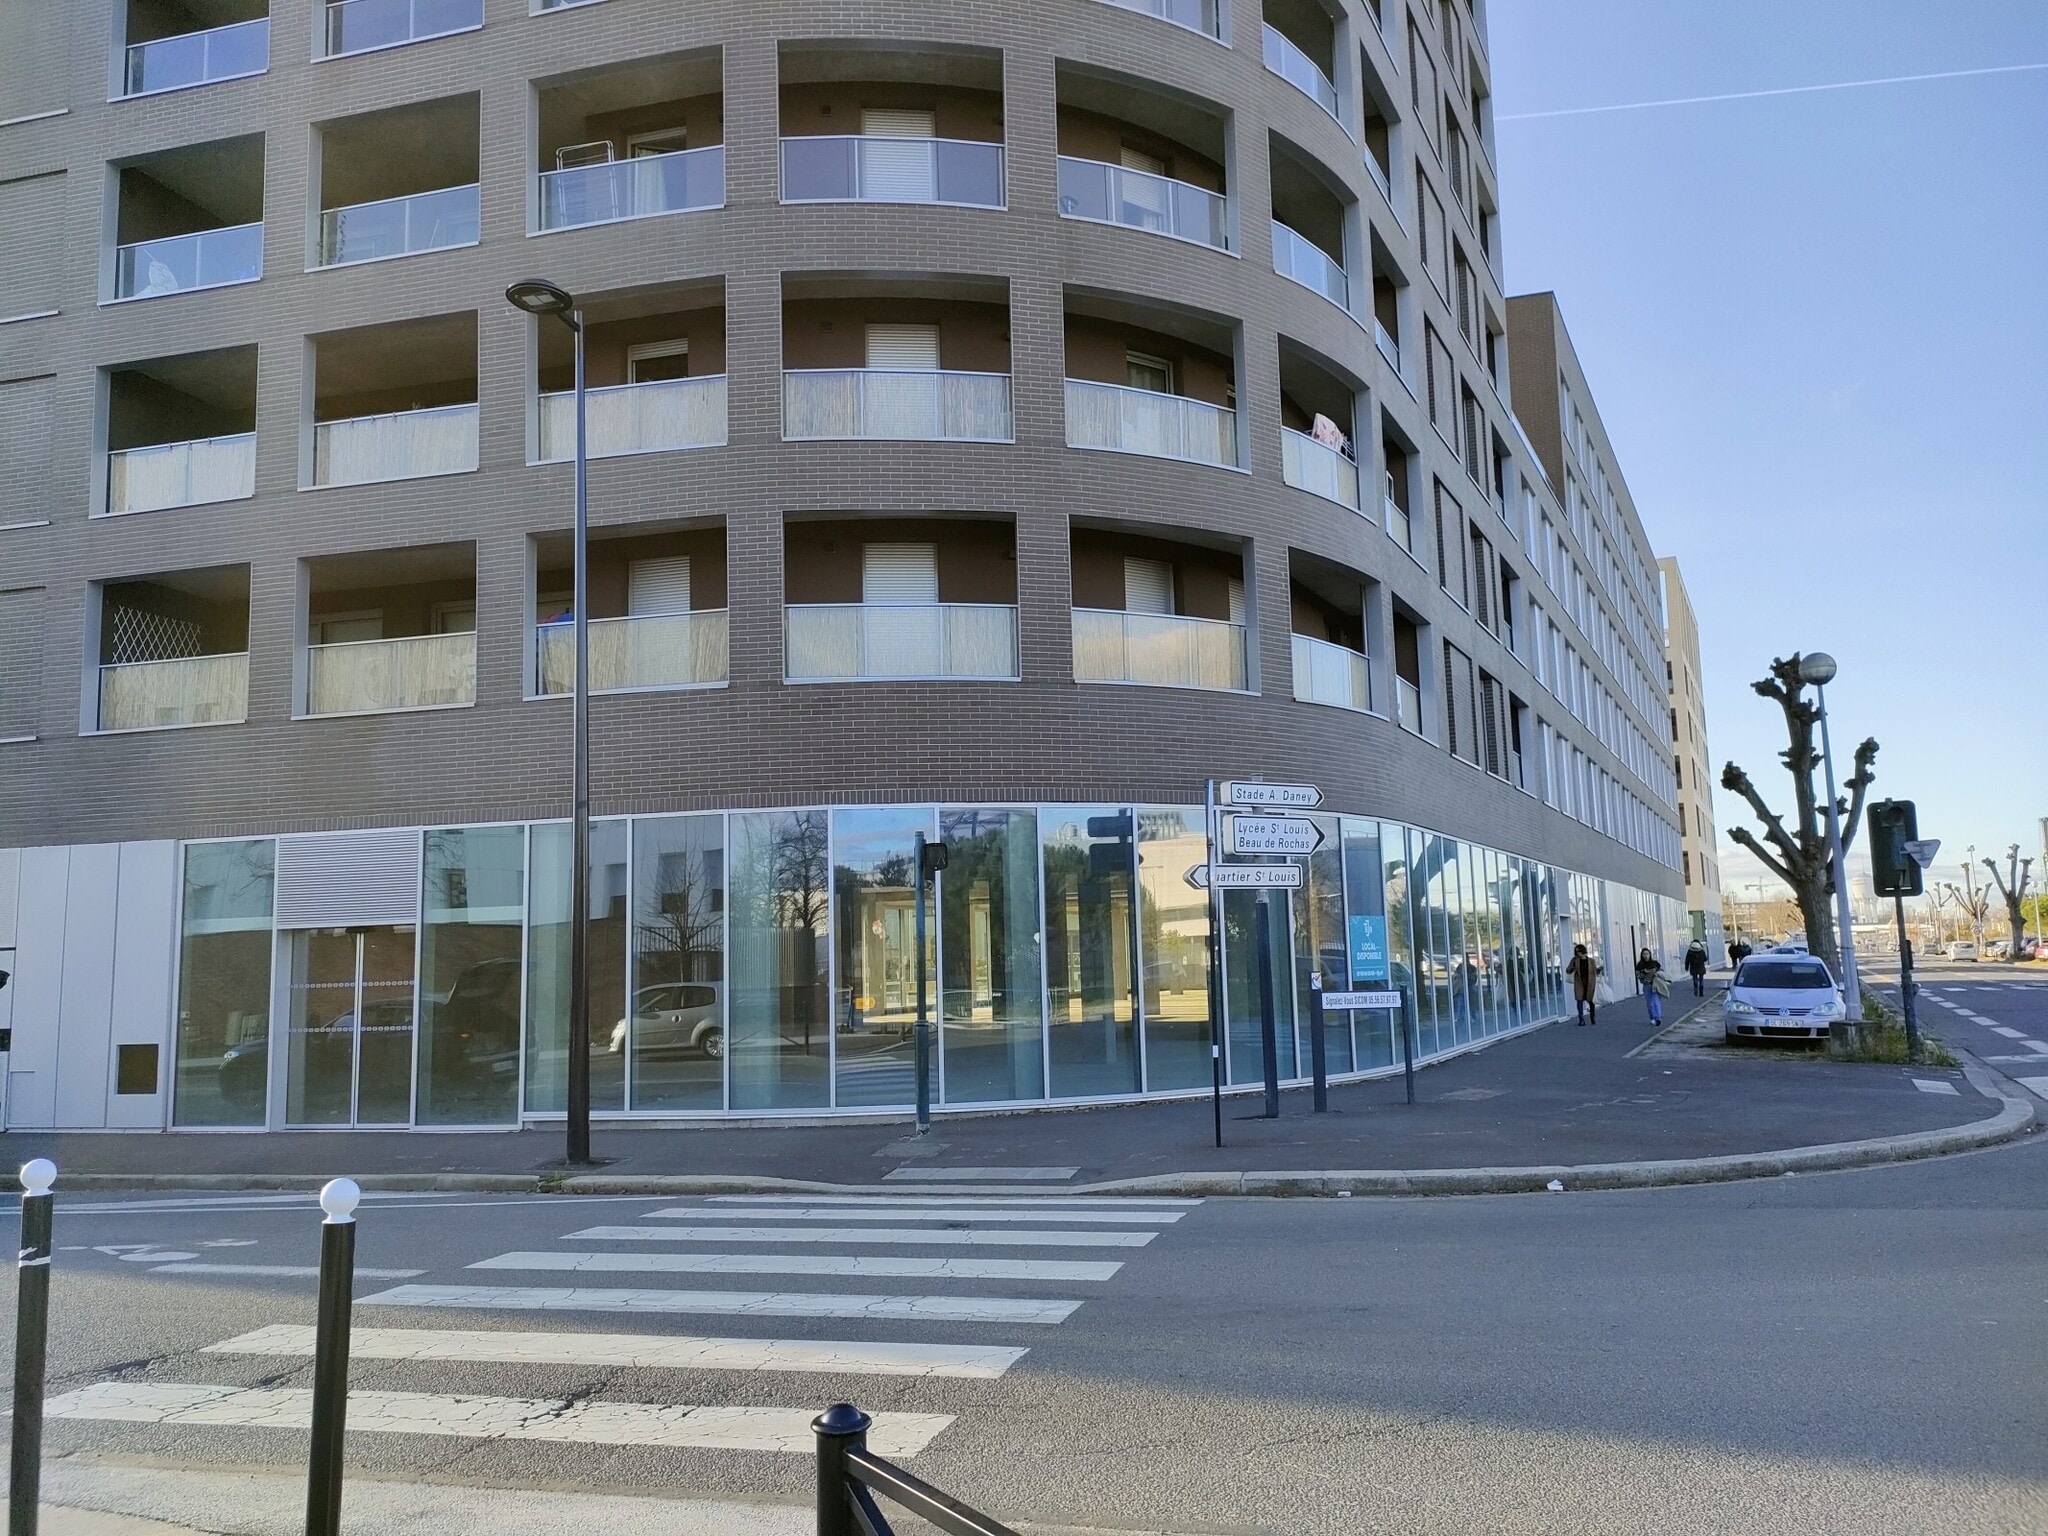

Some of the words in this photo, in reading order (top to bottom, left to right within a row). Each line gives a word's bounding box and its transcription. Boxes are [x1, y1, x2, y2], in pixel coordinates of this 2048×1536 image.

[1236, 788, 1264, 800] Stade
[1269, 789, 1279, 801] A.
[1283, 790, 1312, 803] Daney
[1238, 822, 1266, 835] Lycée
[1271, 823, 1280, 834] St
[1284, 824, 1309, 835] Louis
[1239, 837, 1262, 848] Beau
[1265, 837, 1275, 848] de
[1278, 838, 1310, 849] Rochas
[1255, 871, 1265, 882] St
[1268, 871, 1296, 882] Louis
[1361, 942, 1376, 951] LOCAL
[1356, 951, 1382, 961] DISPONIBLE
